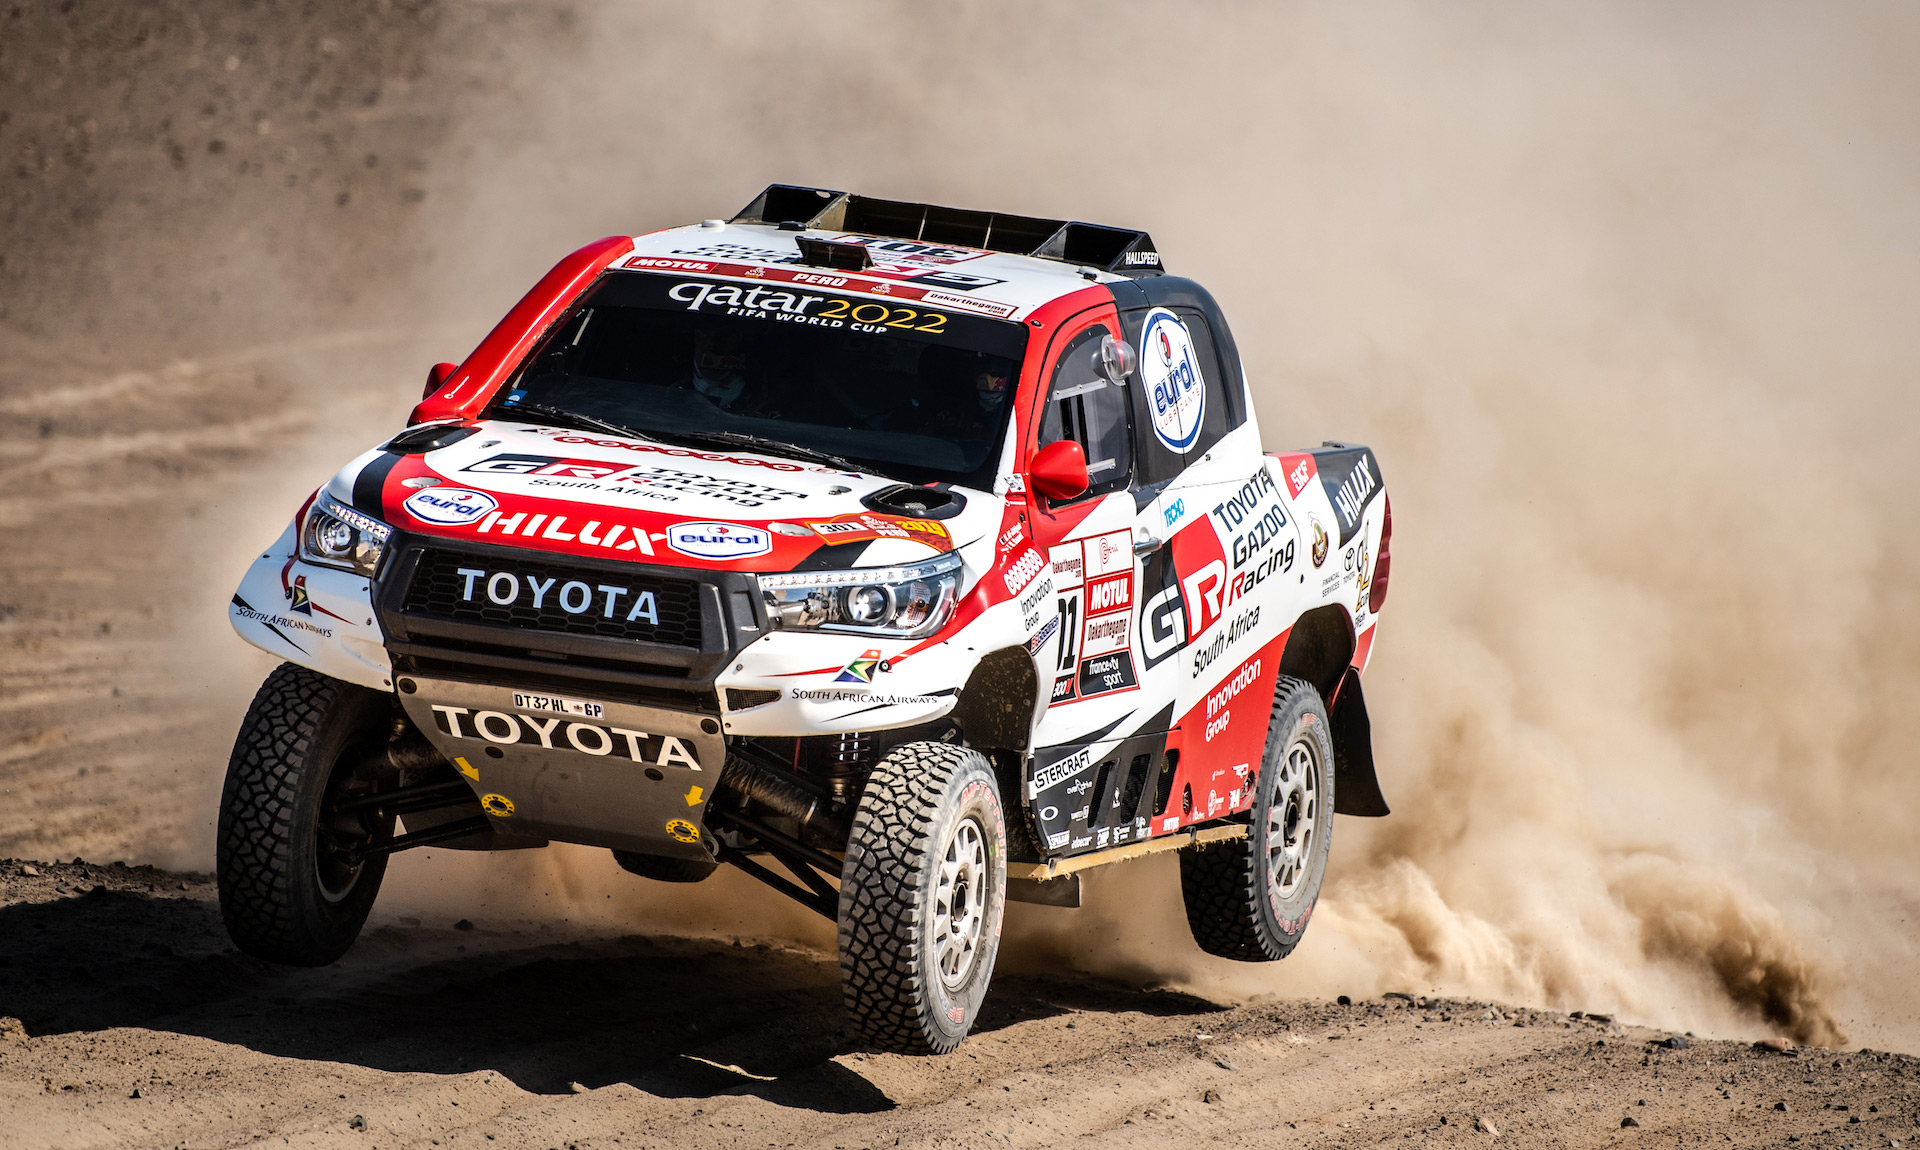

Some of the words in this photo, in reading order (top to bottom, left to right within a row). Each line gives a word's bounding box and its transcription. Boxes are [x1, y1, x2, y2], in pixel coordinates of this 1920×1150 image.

[634, 258, 709, 271] MOTUL
[1125, 251, 1160, 266] HALLSPEED
[792, 272, 848, 288] PERÚ
[668, 282, 824, 313] qatar
[818, 299, 948, 335] 2022
[930, 292, 1008, 313] Dakarthegame
[726, 306, 768, 320] FIFA
[775, 312, 845, 329] WORLD
[850, 322, 888, 336] CUP
[1153, 344, 1198, 417] eurol
[463, 457, 622, 480] GR
[651, 466, 809, 500] TOYOTA
[1289, 459, 1309, 492] SKF
[528, 478, 601, 491] South
[605, 485, 680, 503] Africa
[614, 476, 764, 508] Racing
[630, 472, 782, 502] GAZOO
[1213, 465, 1274, 533] TOYOTA
[1334, 453, 1376, 528] HILUX
[417, 495, 484, 516] eurol
[477, 511, 669, 557] HILUX
[680, 534, 759, 545] eurol
[817, 522, 861, 535] 301
[894, 520, 946, 538] 2019
[1232, 504, 1287, 570] GAZOO
[1052, 557, 1082, 574] Dakarthegame
[1229, 538, 1294, 607] Racing
[456, 566, 660, 626] TOYOTA
[1020, 577, 1054, 617] Innovation
[1090, 577, 1130, 611] MOTUL
[1140, 553, 1228, 662] GR
[236, 606, 268, 623] SOUTH
[270, 614, 304, 631] AFRICAN
[1024, 611, 1040, 632] Group
[1087, 618, 1127, 641] Dakarthegame
[1192, 630, 1225, 679] South
[1226, 605, 1261, 650] Africa
[1052, 676, 1074, 698] 300V
[1103, 669, 1124, 690] sport
[1207, 659, 1261, 718] Innovation
[584, 703, 602, 717] GP
[792, 687, 831, 701] SOUTH
[832, 691, 885, 704] AFRICAN
[888, 694, 938, 705] AIRWAYS
[431, 703, 703, 772] TOYOTA
[1206, 709, 1231, 743] Group
[1301, 711, 1334, 852] BFGoodrich
[960, 780, 1006, 869] All-Terrain
[994, 883, 1006, 937] T/A
